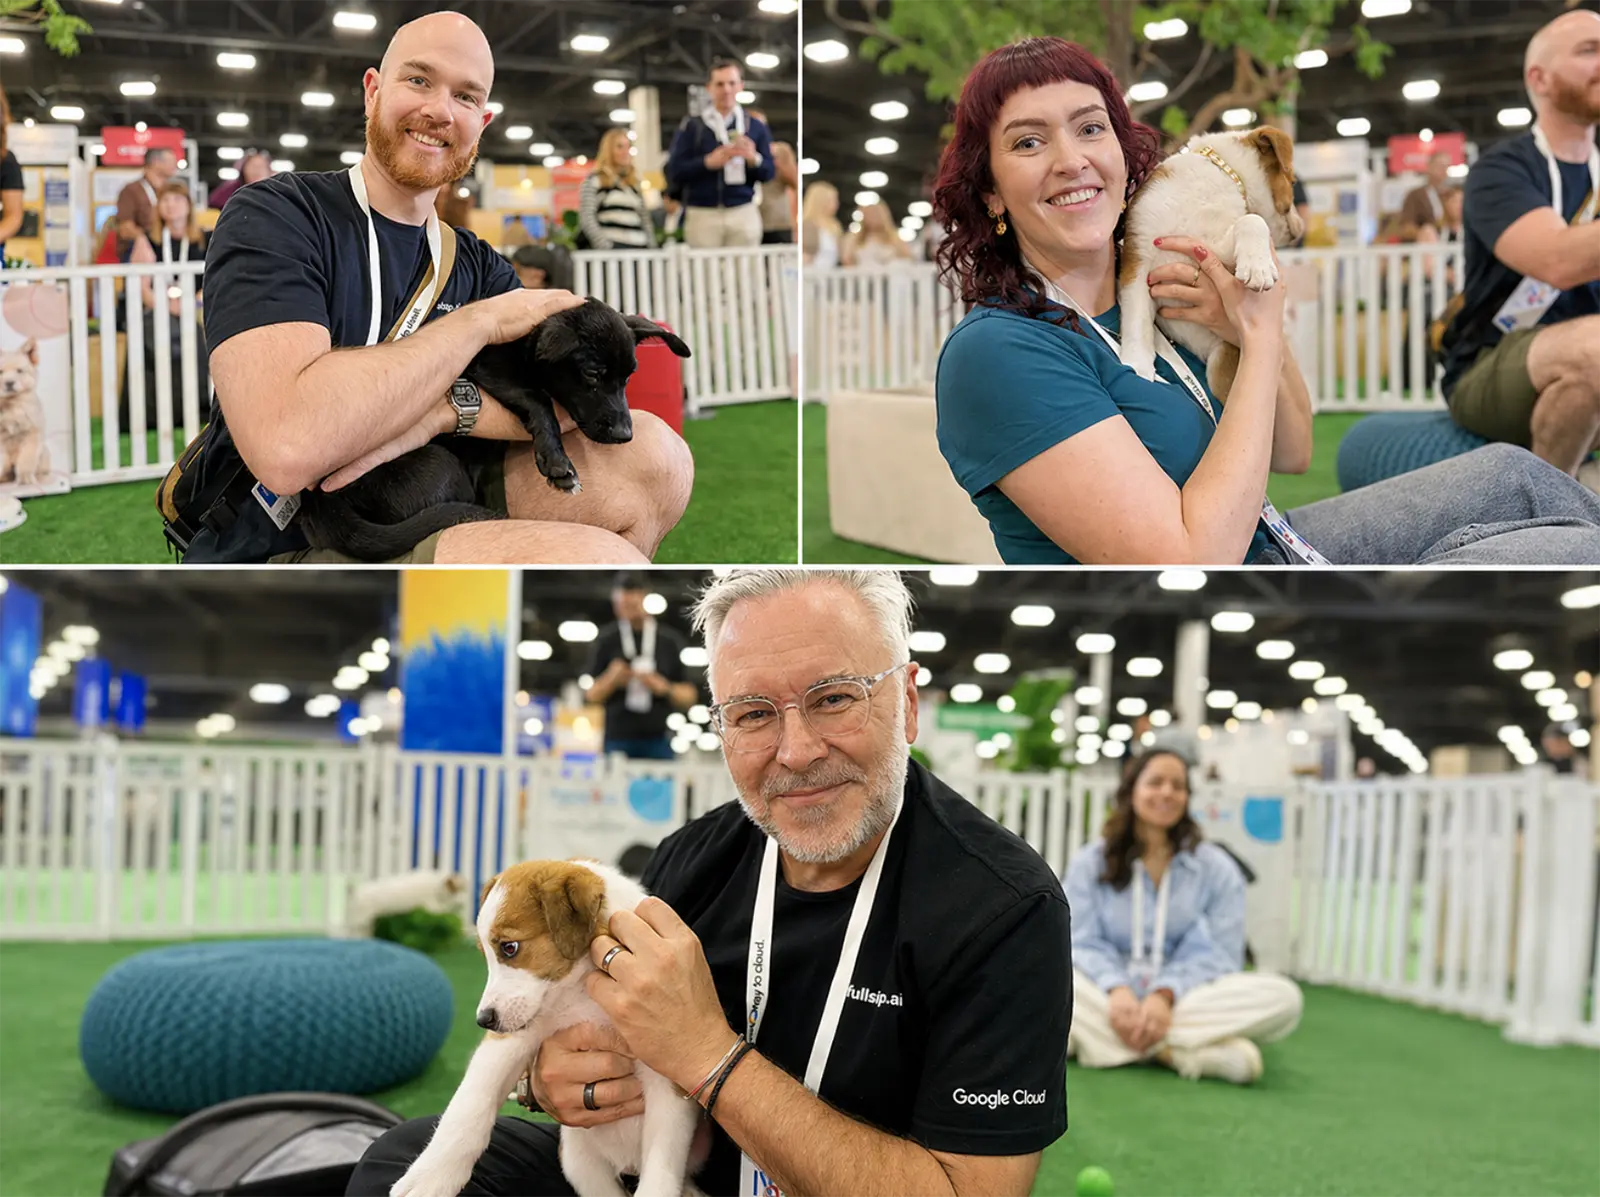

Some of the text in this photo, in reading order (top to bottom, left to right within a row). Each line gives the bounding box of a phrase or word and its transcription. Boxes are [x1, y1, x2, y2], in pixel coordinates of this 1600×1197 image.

[753, 939, 765, 974] cloud.
[846, 984, 903, 1007] fullsip.ai
[952, 1087, 1047, 1110] Google Cloud
